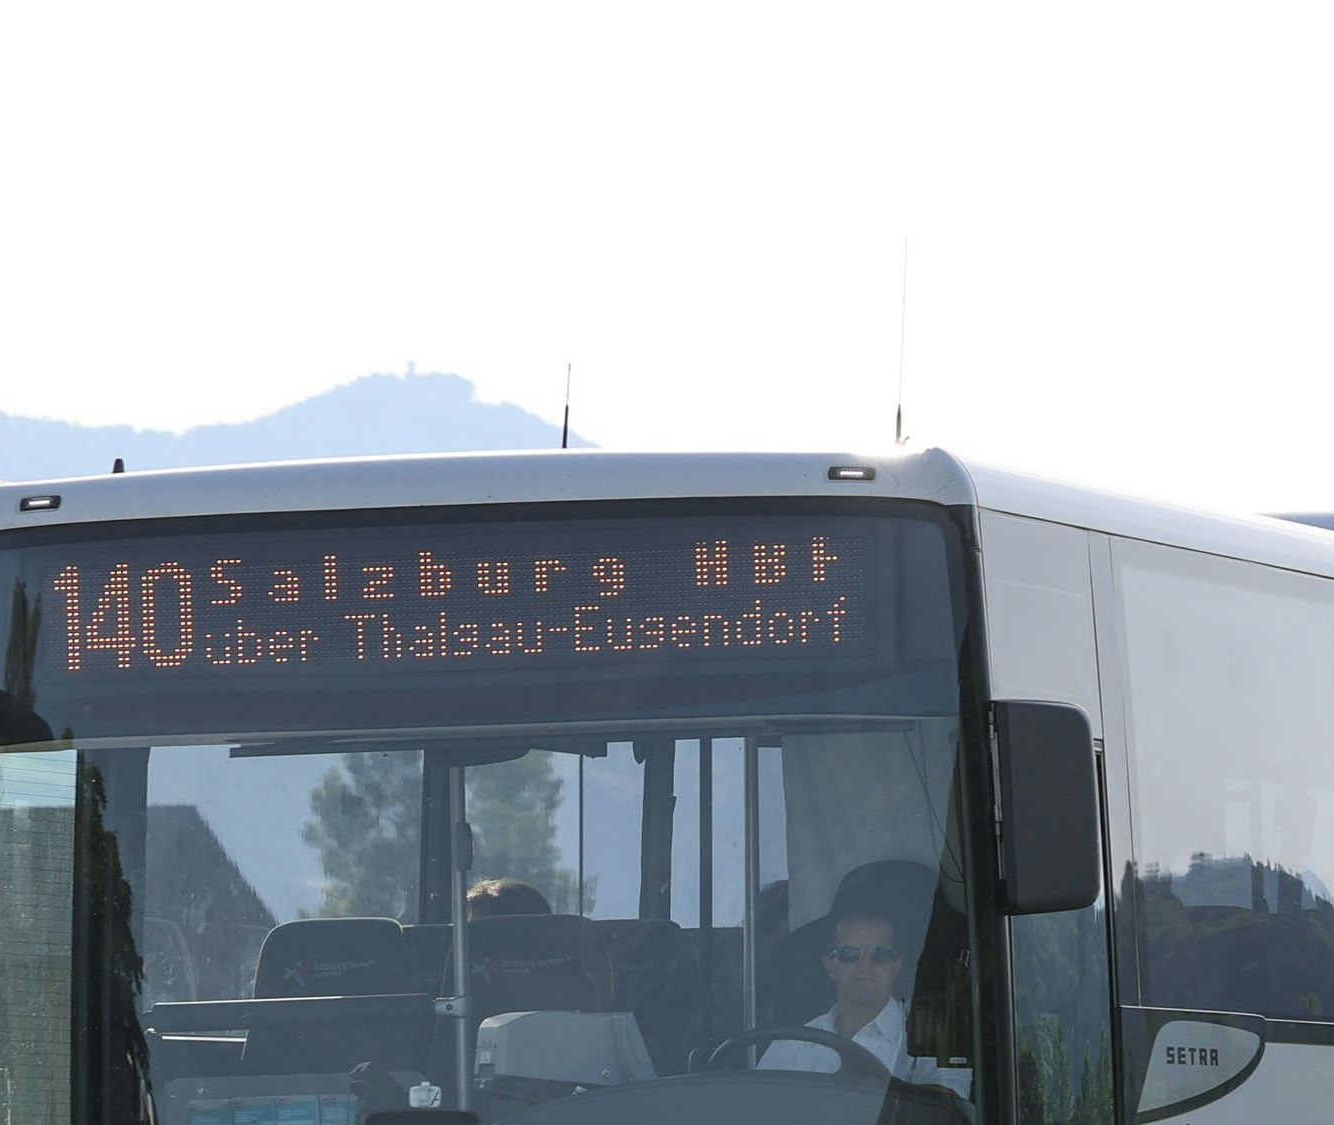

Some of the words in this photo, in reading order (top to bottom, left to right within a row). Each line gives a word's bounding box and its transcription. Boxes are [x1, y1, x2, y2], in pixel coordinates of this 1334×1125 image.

[210, 551, 625, 605] Salzburg
[52, 560, 193, 670] 140
[205, 618, 319, 665] über
[344, 595, 847, 661] Thalgau-Eugendorf
[1166, 1046, 1219, 1066] SETRA
